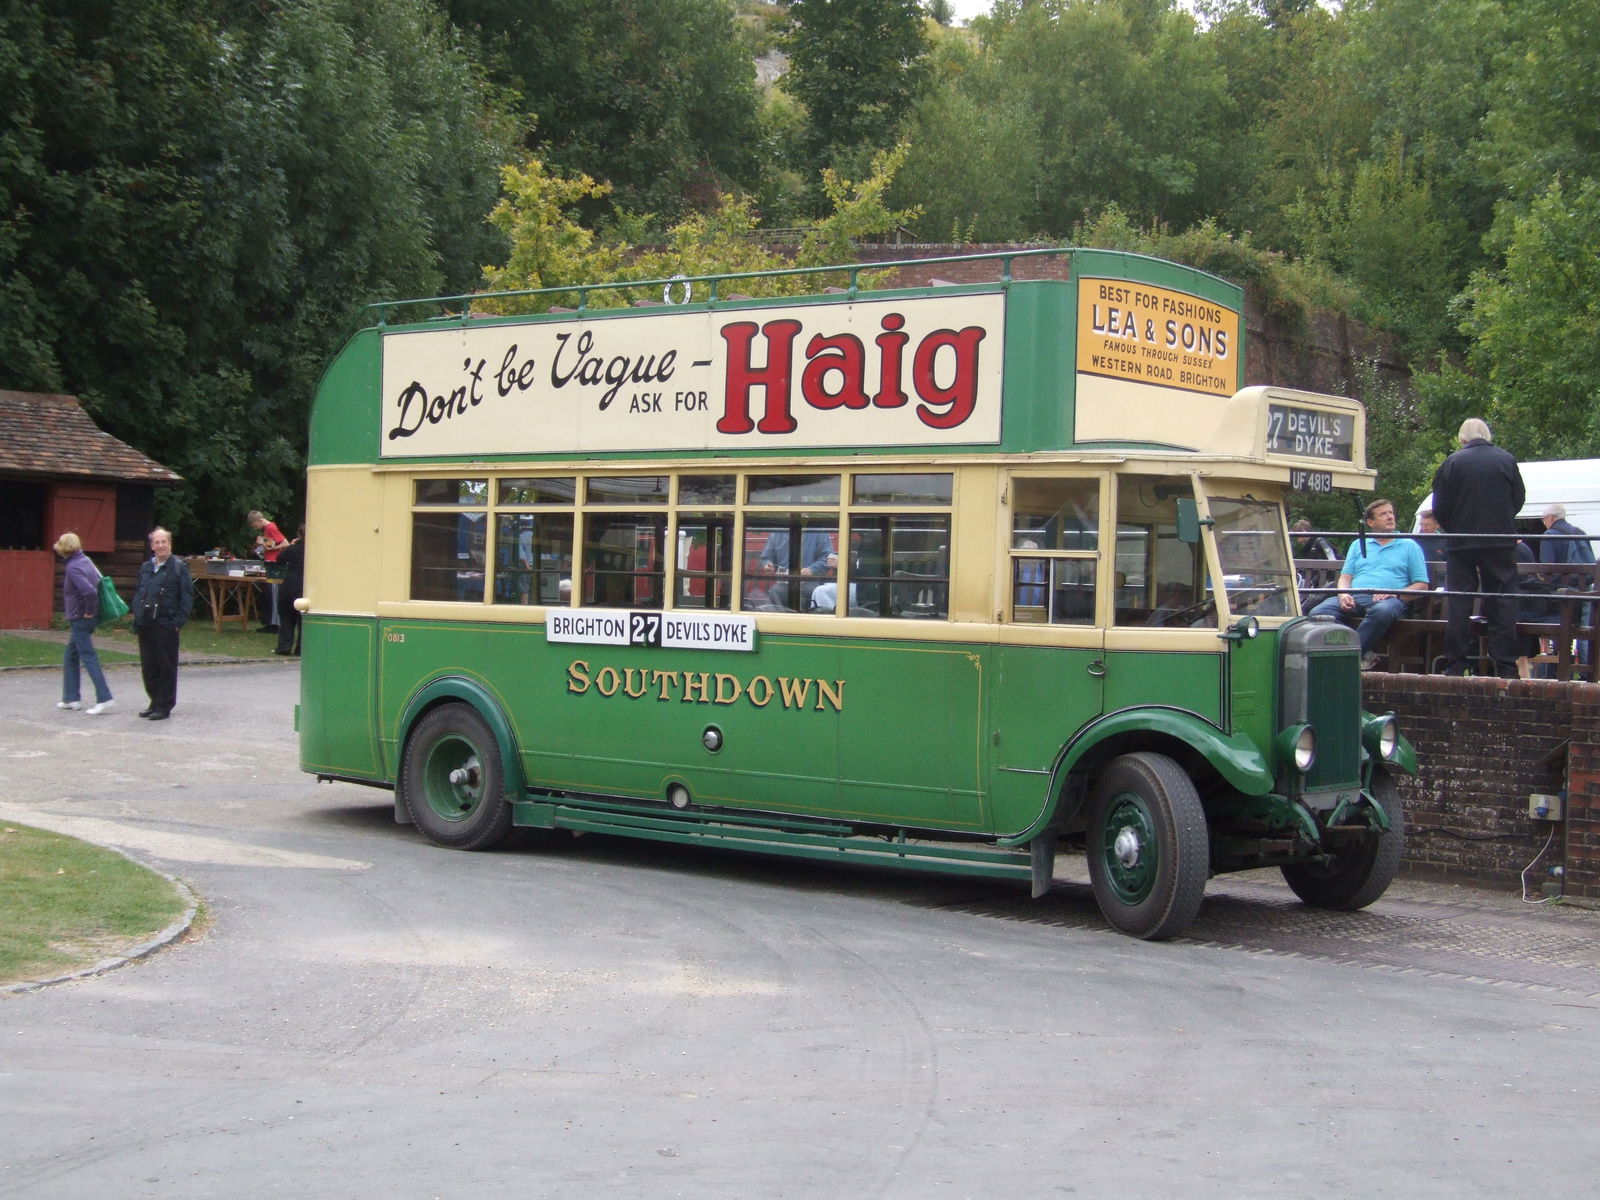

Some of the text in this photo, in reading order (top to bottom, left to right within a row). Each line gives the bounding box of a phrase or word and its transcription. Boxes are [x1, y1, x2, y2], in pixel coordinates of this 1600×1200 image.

[1099, 285, 1221, 324] BEST FOR FASHIONS
[1092, 304, 1228, 357] LEA & SONS
[1103, 340, 1213, 370] FAMOUS THROUGH SUSSEX
[389, 357, 487, 441] Don't
[494, 344, 535, 397] be
[551, 330, 677, 411] Vague
[716, 312, 986, 434] Haig
[1092, 355, 1142, 374] WESTERN
[1180, 371, 1226, 389] BRIGHTON
[629, 391, 708, 413] ASK FOR
[1288, 413, 1341, 436] DEVIL'S
[1295, 435, 1334, 455] DYKE
[1292, 471, 1331, 492] UF 4813
[553, 615, 747, 643] BRIGHTON 27 DEVIL'S DYKE
[567, 660, 847, 712] SOUTHDOWN
